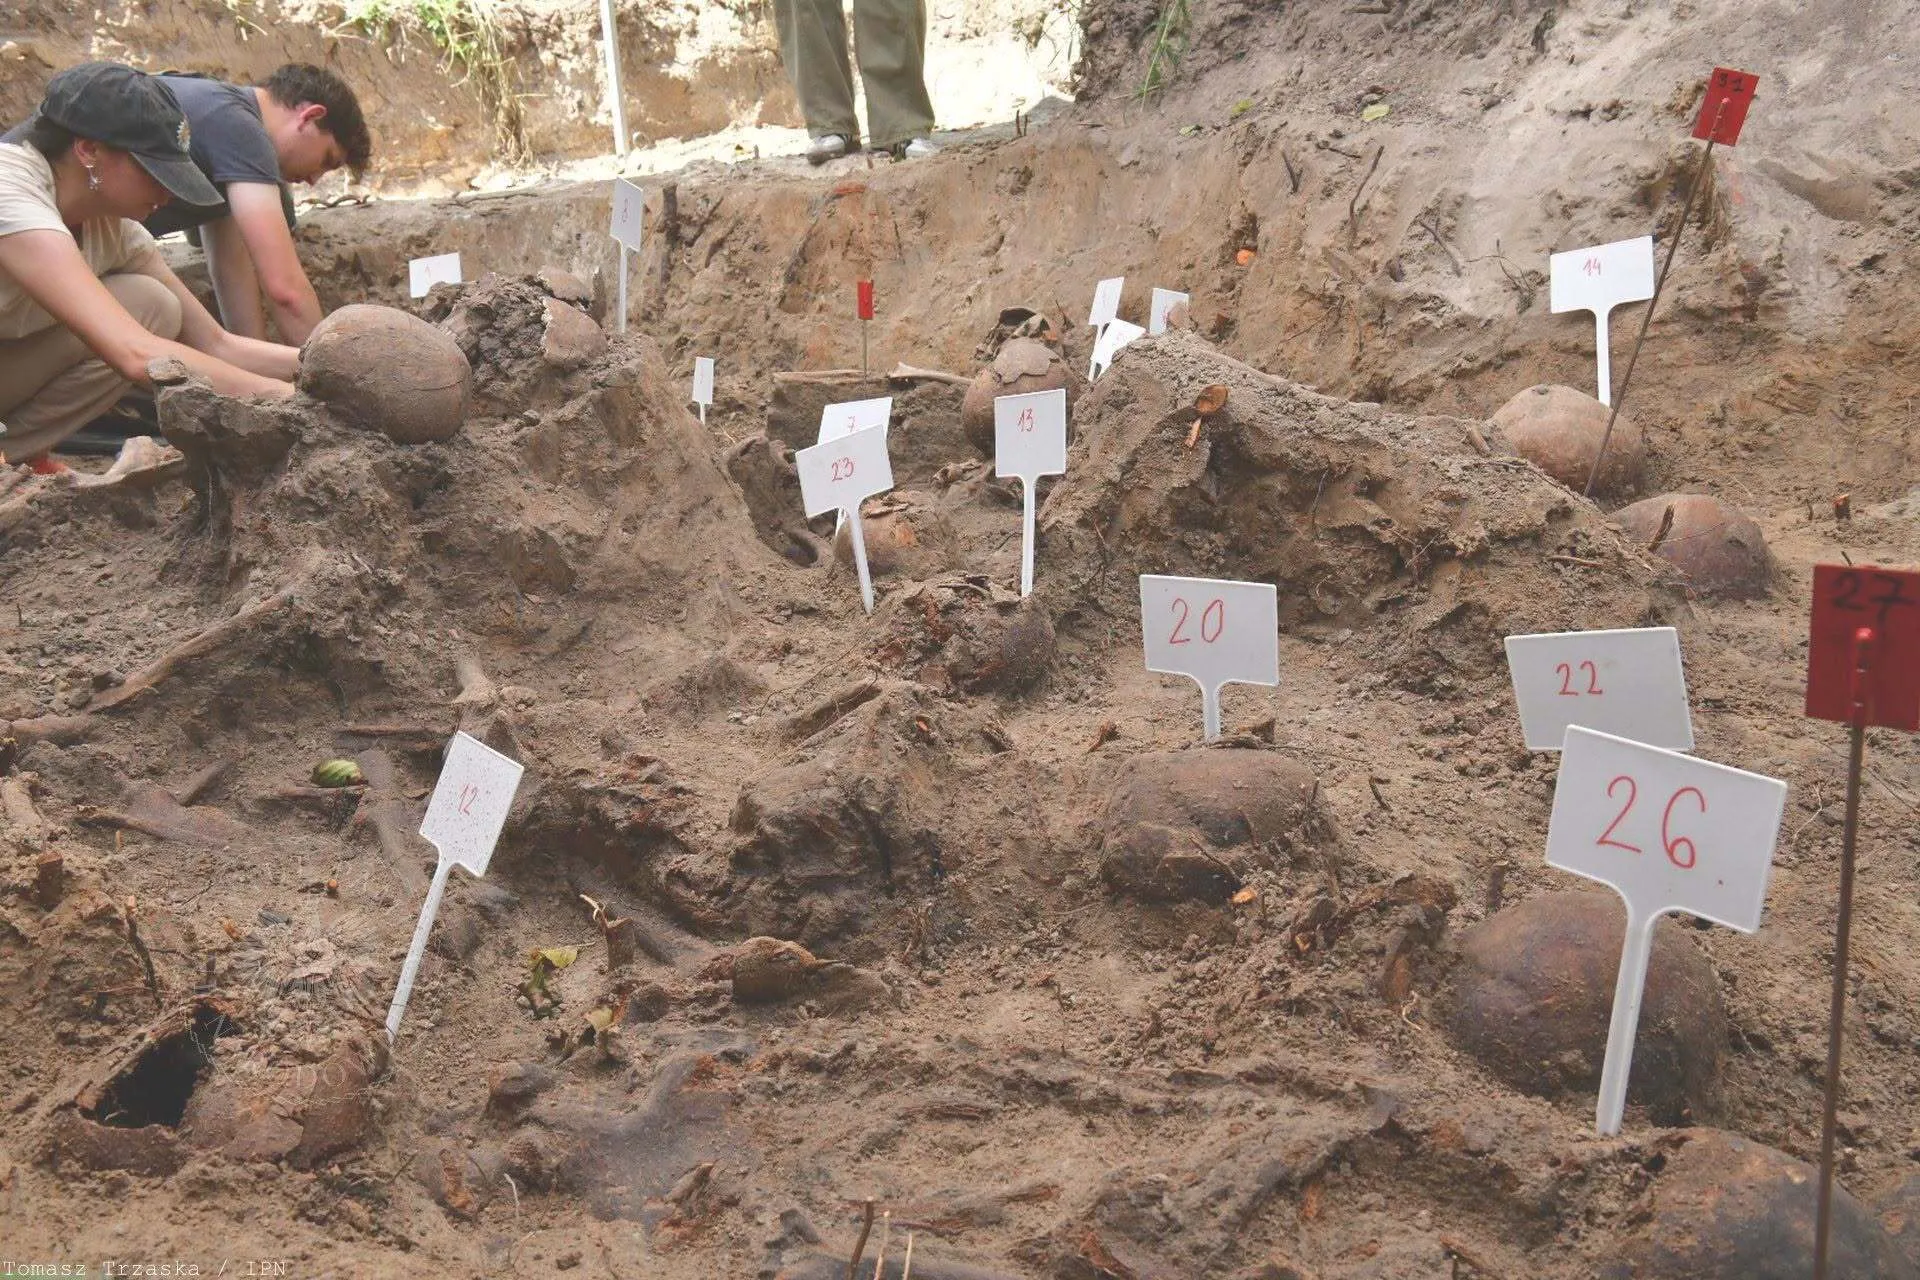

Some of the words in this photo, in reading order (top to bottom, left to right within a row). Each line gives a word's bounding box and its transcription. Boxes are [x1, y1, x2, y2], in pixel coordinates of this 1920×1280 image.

[1017, 407, 1034, 433] 13
[830, 456, 855, 483] 23
[1831, 571, 1917, 624] 27
[1169, 597, 1224, 645] 20
[1555, 659, 1604, 697] 22
[458, 782, 479, 817] 12
[1595, 774, 1707, 870] 26
